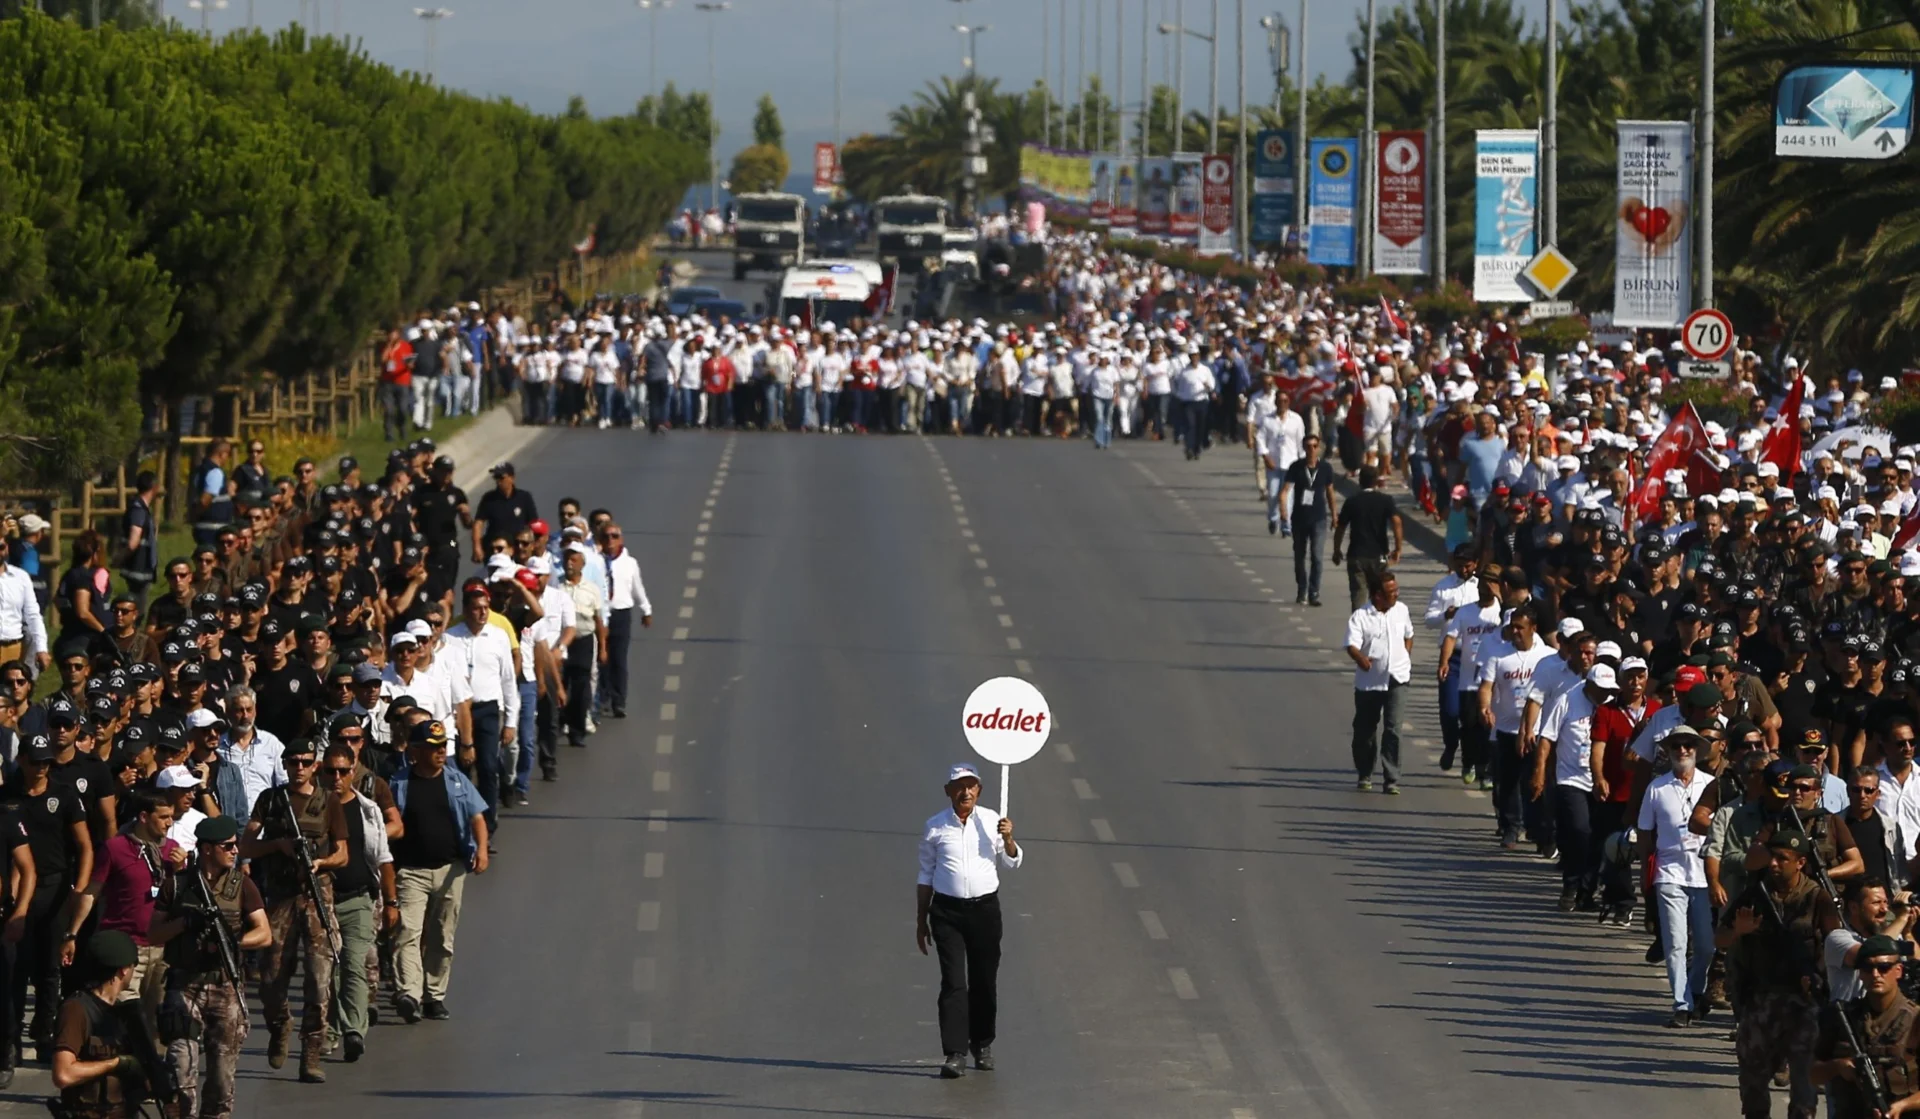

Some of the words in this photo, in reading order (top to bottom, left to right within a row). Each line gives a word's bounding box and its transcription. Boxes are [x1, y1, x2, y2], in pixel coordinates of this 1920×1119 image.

[1781, 135, 1806, 146] 444
[1810, 135, 1816, 146] 5
[1820, 135, 1836, 147] 111
[1623, 276, 1680, 291] BİRUNİ
[1694, 324, 1722, 346] 70
[1504, 668, 1532, 680] adal
[966, 707, 1046, 733] adalet
